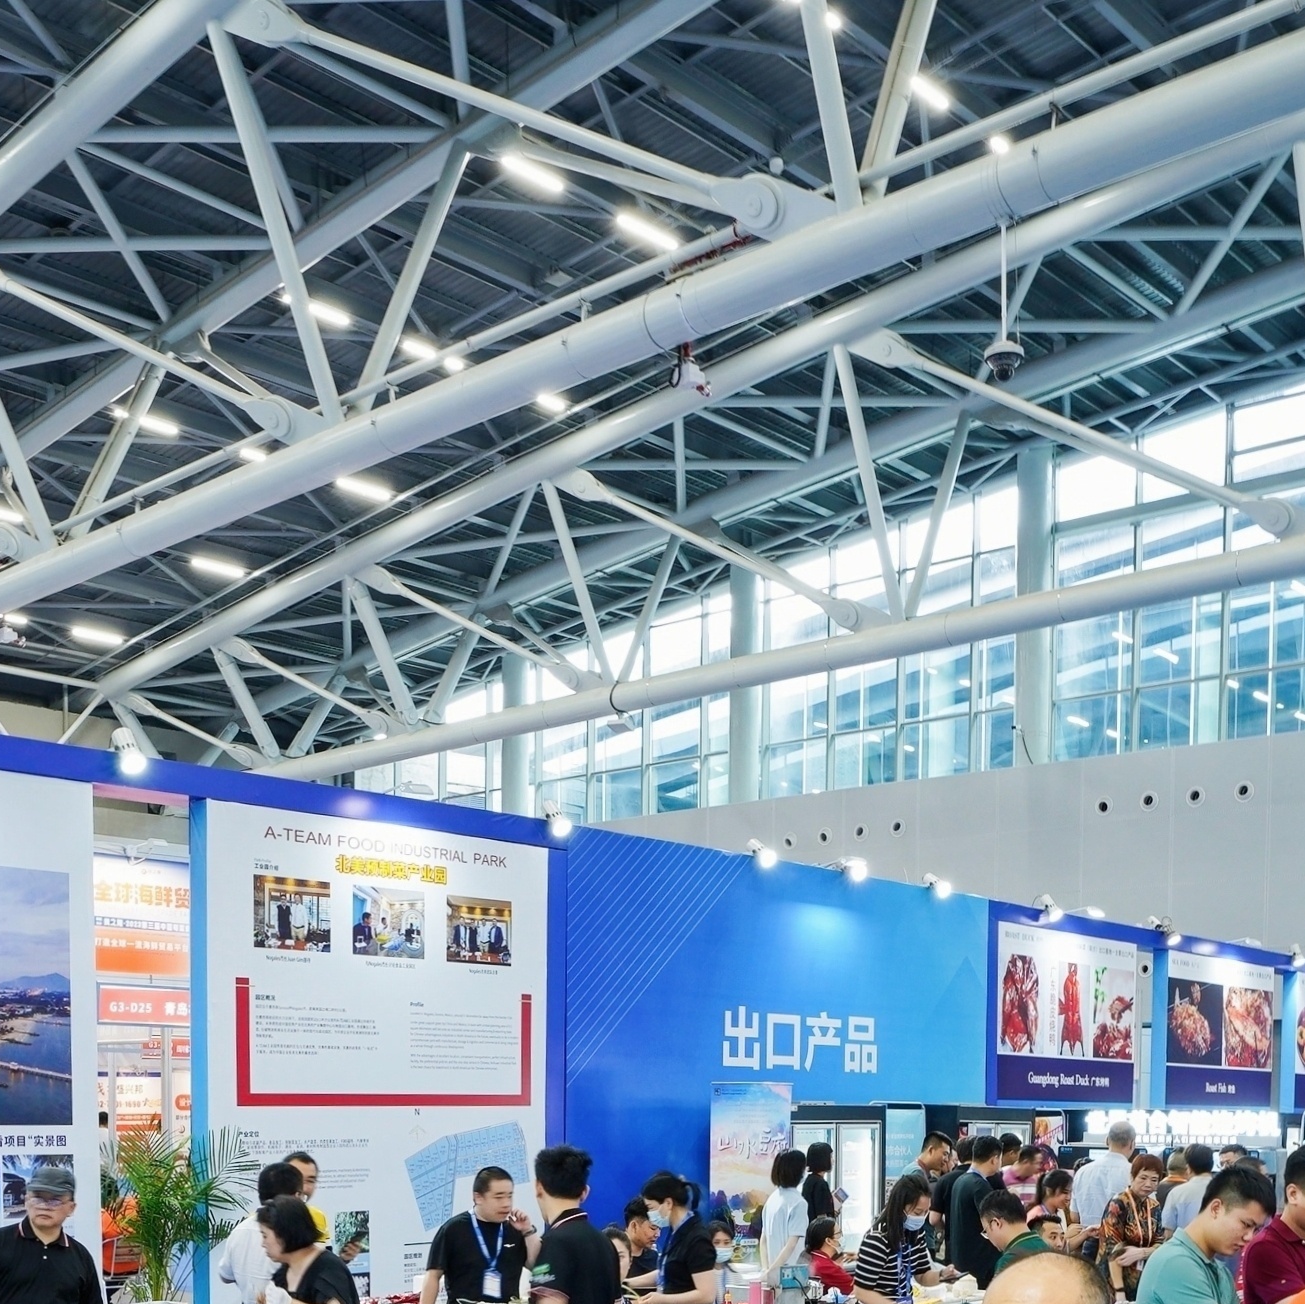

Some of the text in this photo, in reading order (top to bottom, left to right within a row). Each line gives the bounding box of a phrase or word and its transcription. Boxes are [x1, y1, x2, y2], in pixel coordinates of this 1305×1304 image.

[264, 825, 508, 868] A-TEAM FOOD INDUSTRIAL PARK
[335, 853, 448, 886] 北美预制菜产业园
[109, 1001, 153, 1014] G3-D25
[722, 1005, 878, 1075] 出口产品
[1028, 1071, 1059, 1088] Guangdong
[1060, 1073, 1075, 1086] Roast
[1076, 1073, 1090, 1086] Duck
